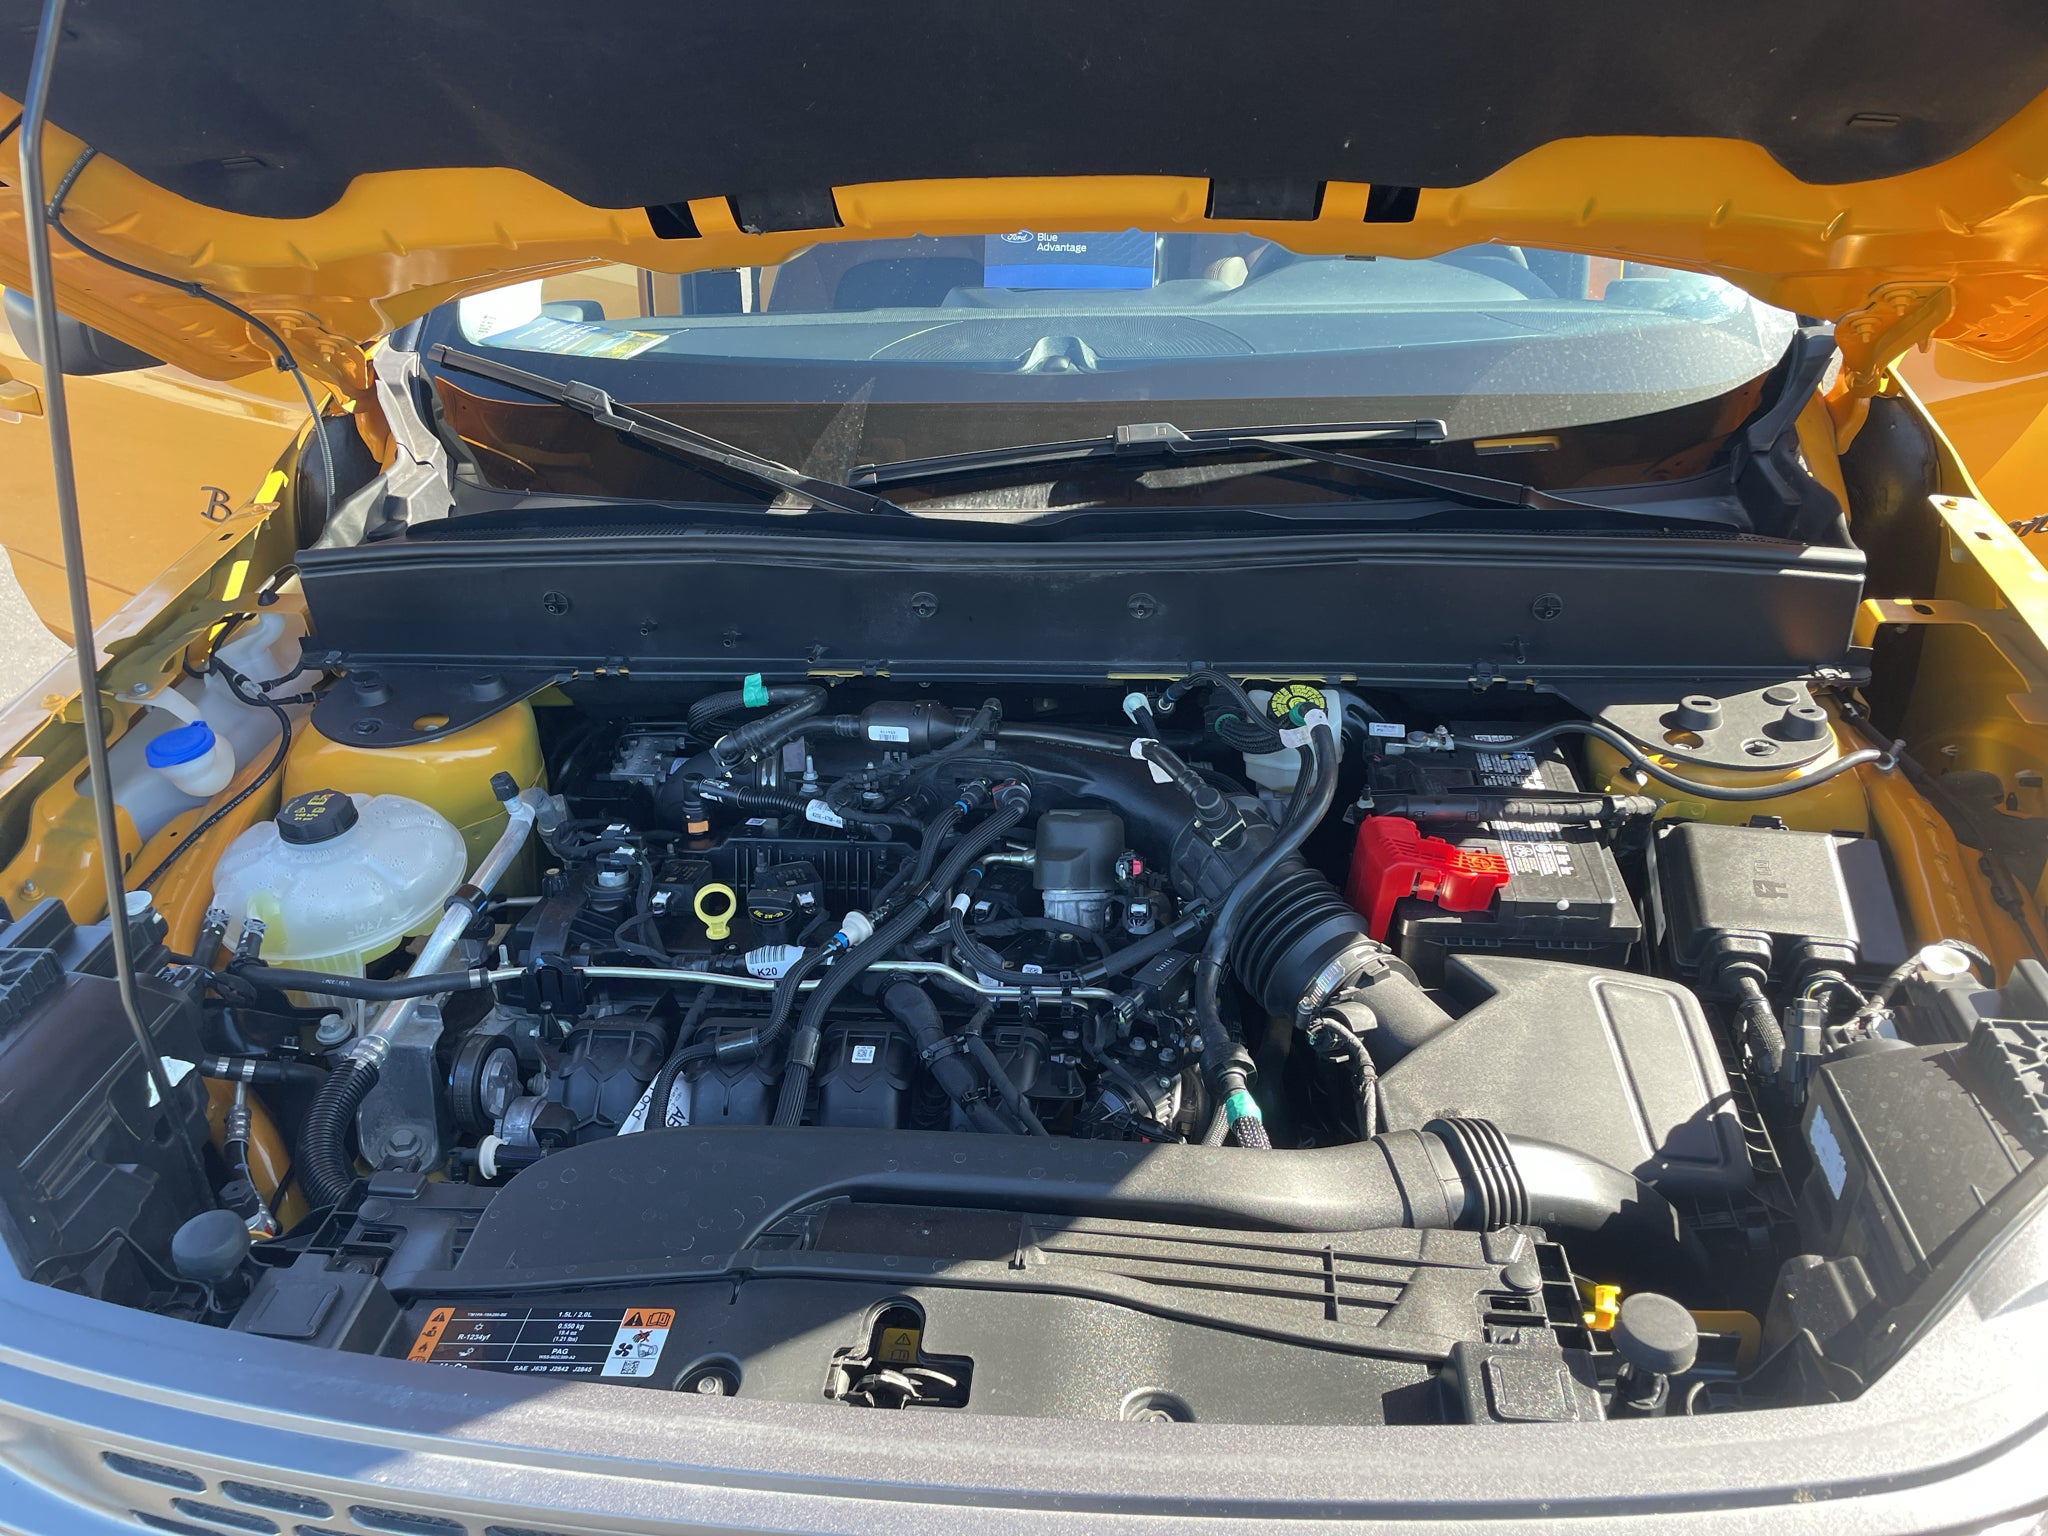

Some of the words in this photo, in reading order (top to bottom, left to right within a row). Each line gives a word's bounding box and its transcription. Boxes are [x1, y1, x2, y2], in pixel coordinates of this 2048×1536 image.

[1037, 233, 1058, 242] Blue
[1036, 243, 1087, 253] Advantage
[757, 967, 778, 976] K20
[575, 1323, 585, 1331] kg
[457, 1333, 491, 1342] R-1234yf
